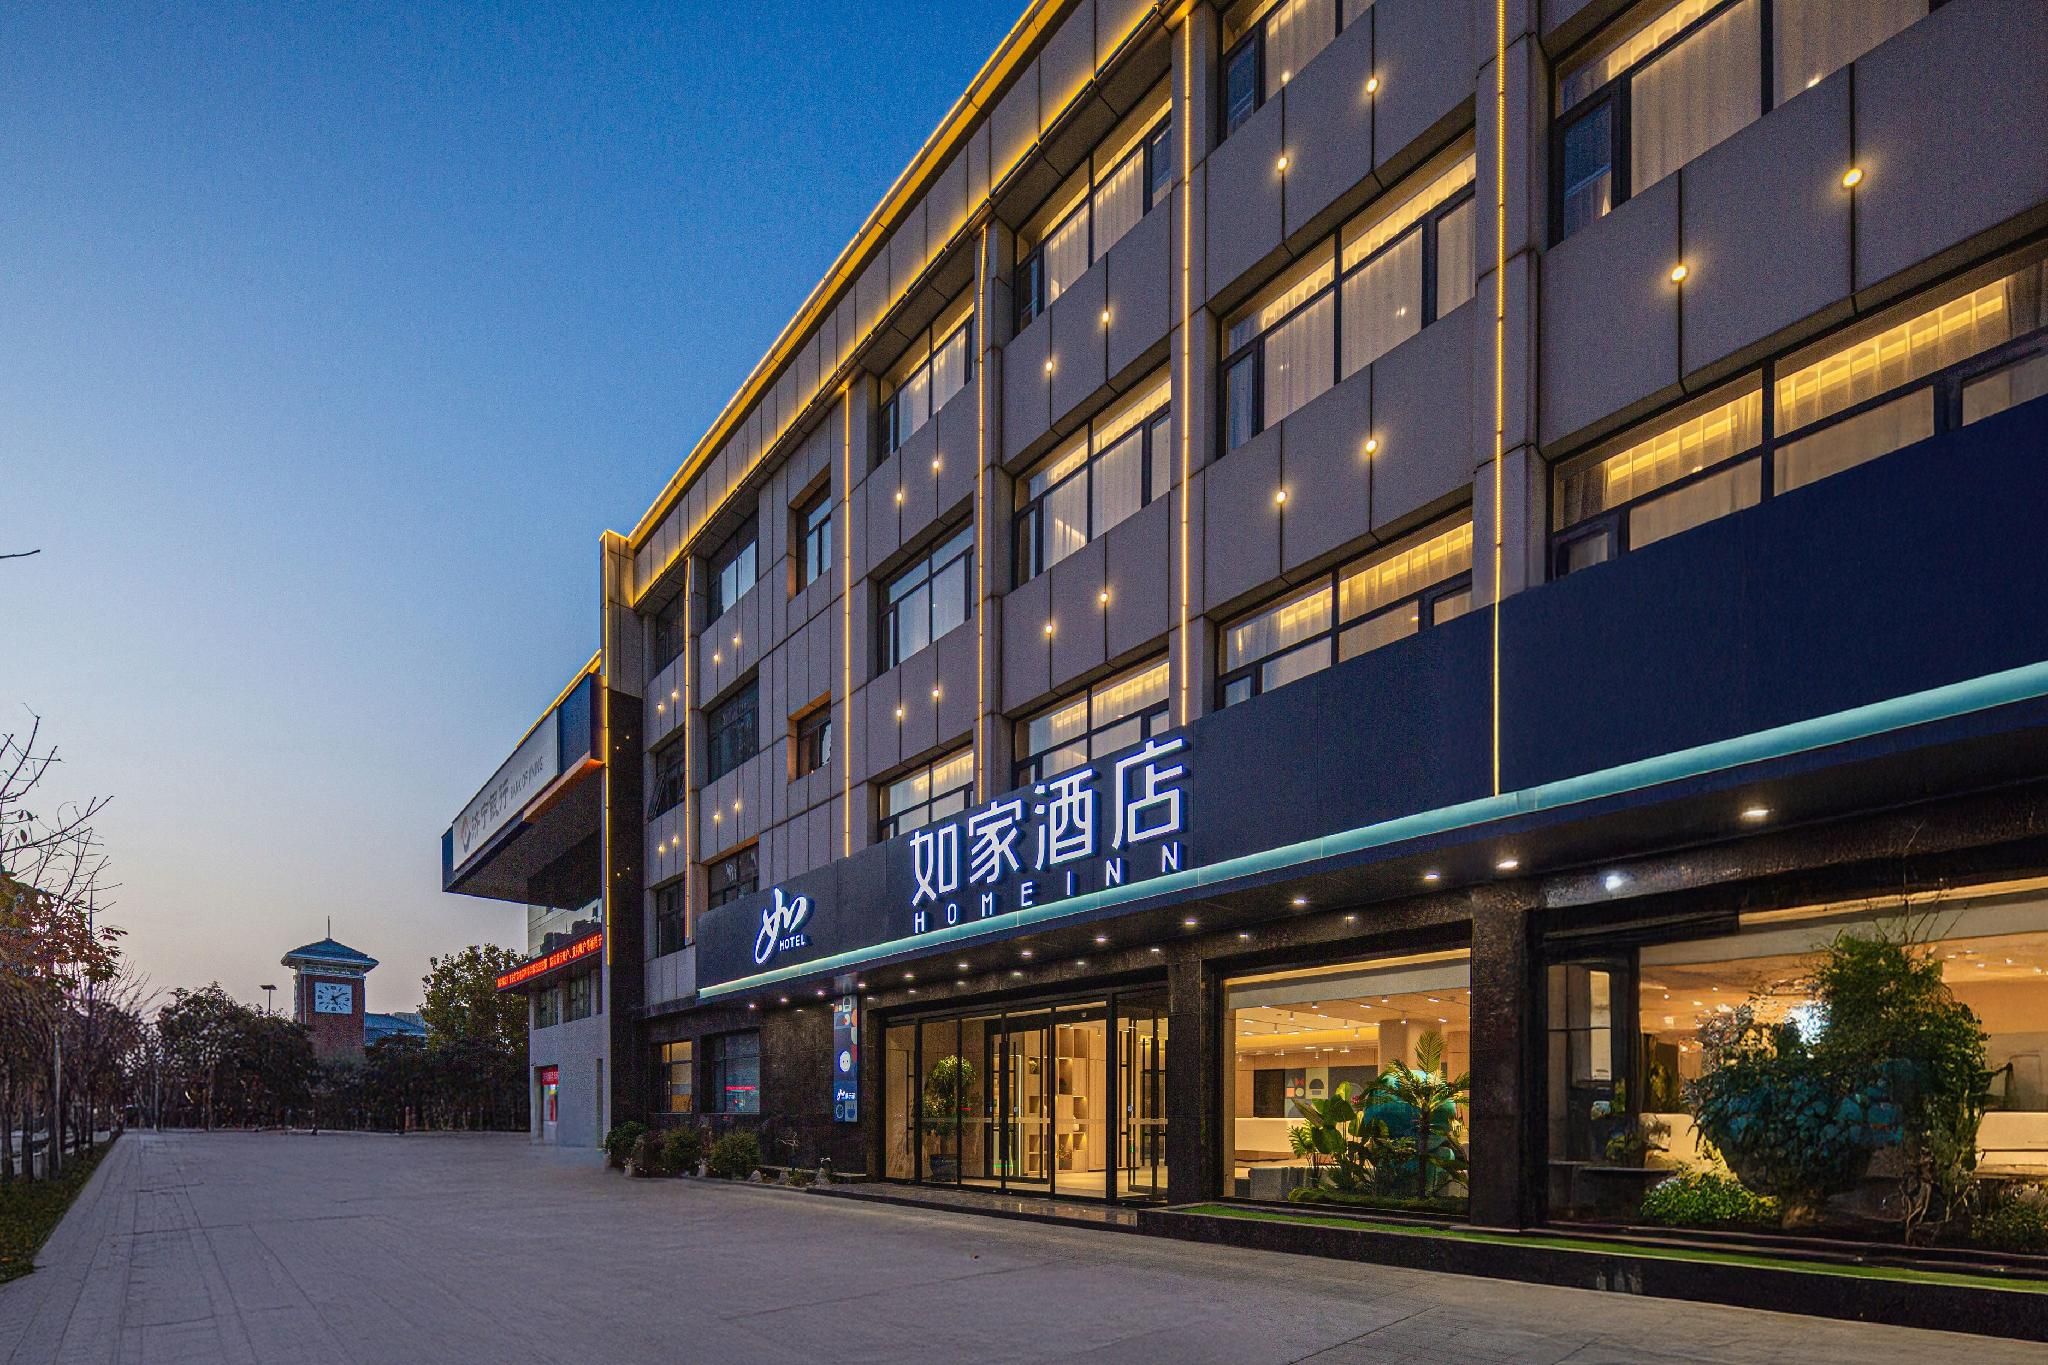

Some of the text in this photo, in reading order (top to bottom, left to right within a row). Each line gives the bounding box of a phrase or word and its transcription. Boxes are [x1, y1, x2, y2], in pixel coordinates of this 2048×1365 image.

[910, 738, 1182, 906] 如家酒店
[779, 934, 806, 951] HOTEL
